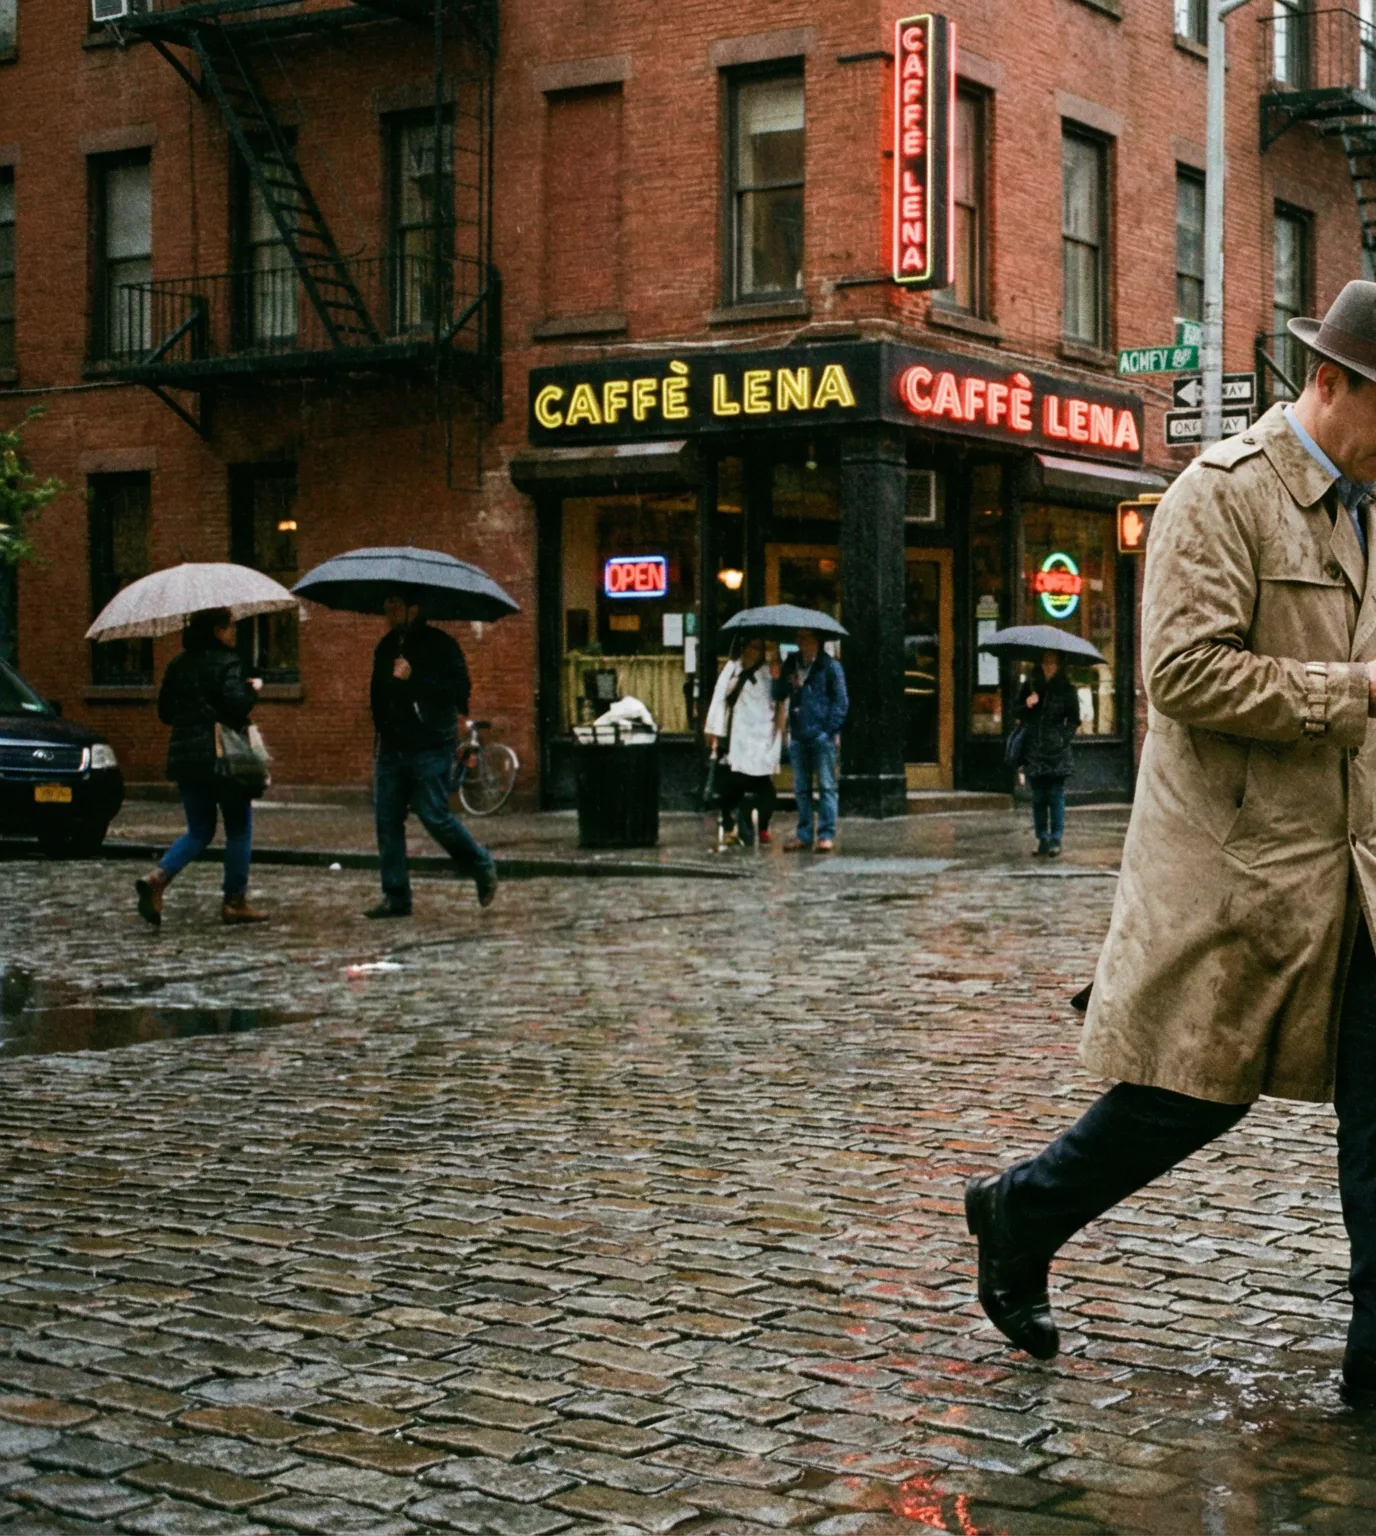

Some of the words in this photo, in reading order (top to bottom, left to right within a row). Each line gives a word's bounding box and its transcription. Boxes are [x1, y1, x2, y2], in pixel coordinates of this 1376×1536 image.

[902, 170, 924, 270] LENA
[534, 360, 689, 429] CAFFÈ
[713, 364, 855, 416] LENA
[900, 365, 1034, 432] CAFFÈ
[1044, 394, 1141, 451] LENA
[1221, 418, 1240, 431] AY
[609, 562, 665, 592] OPEN
